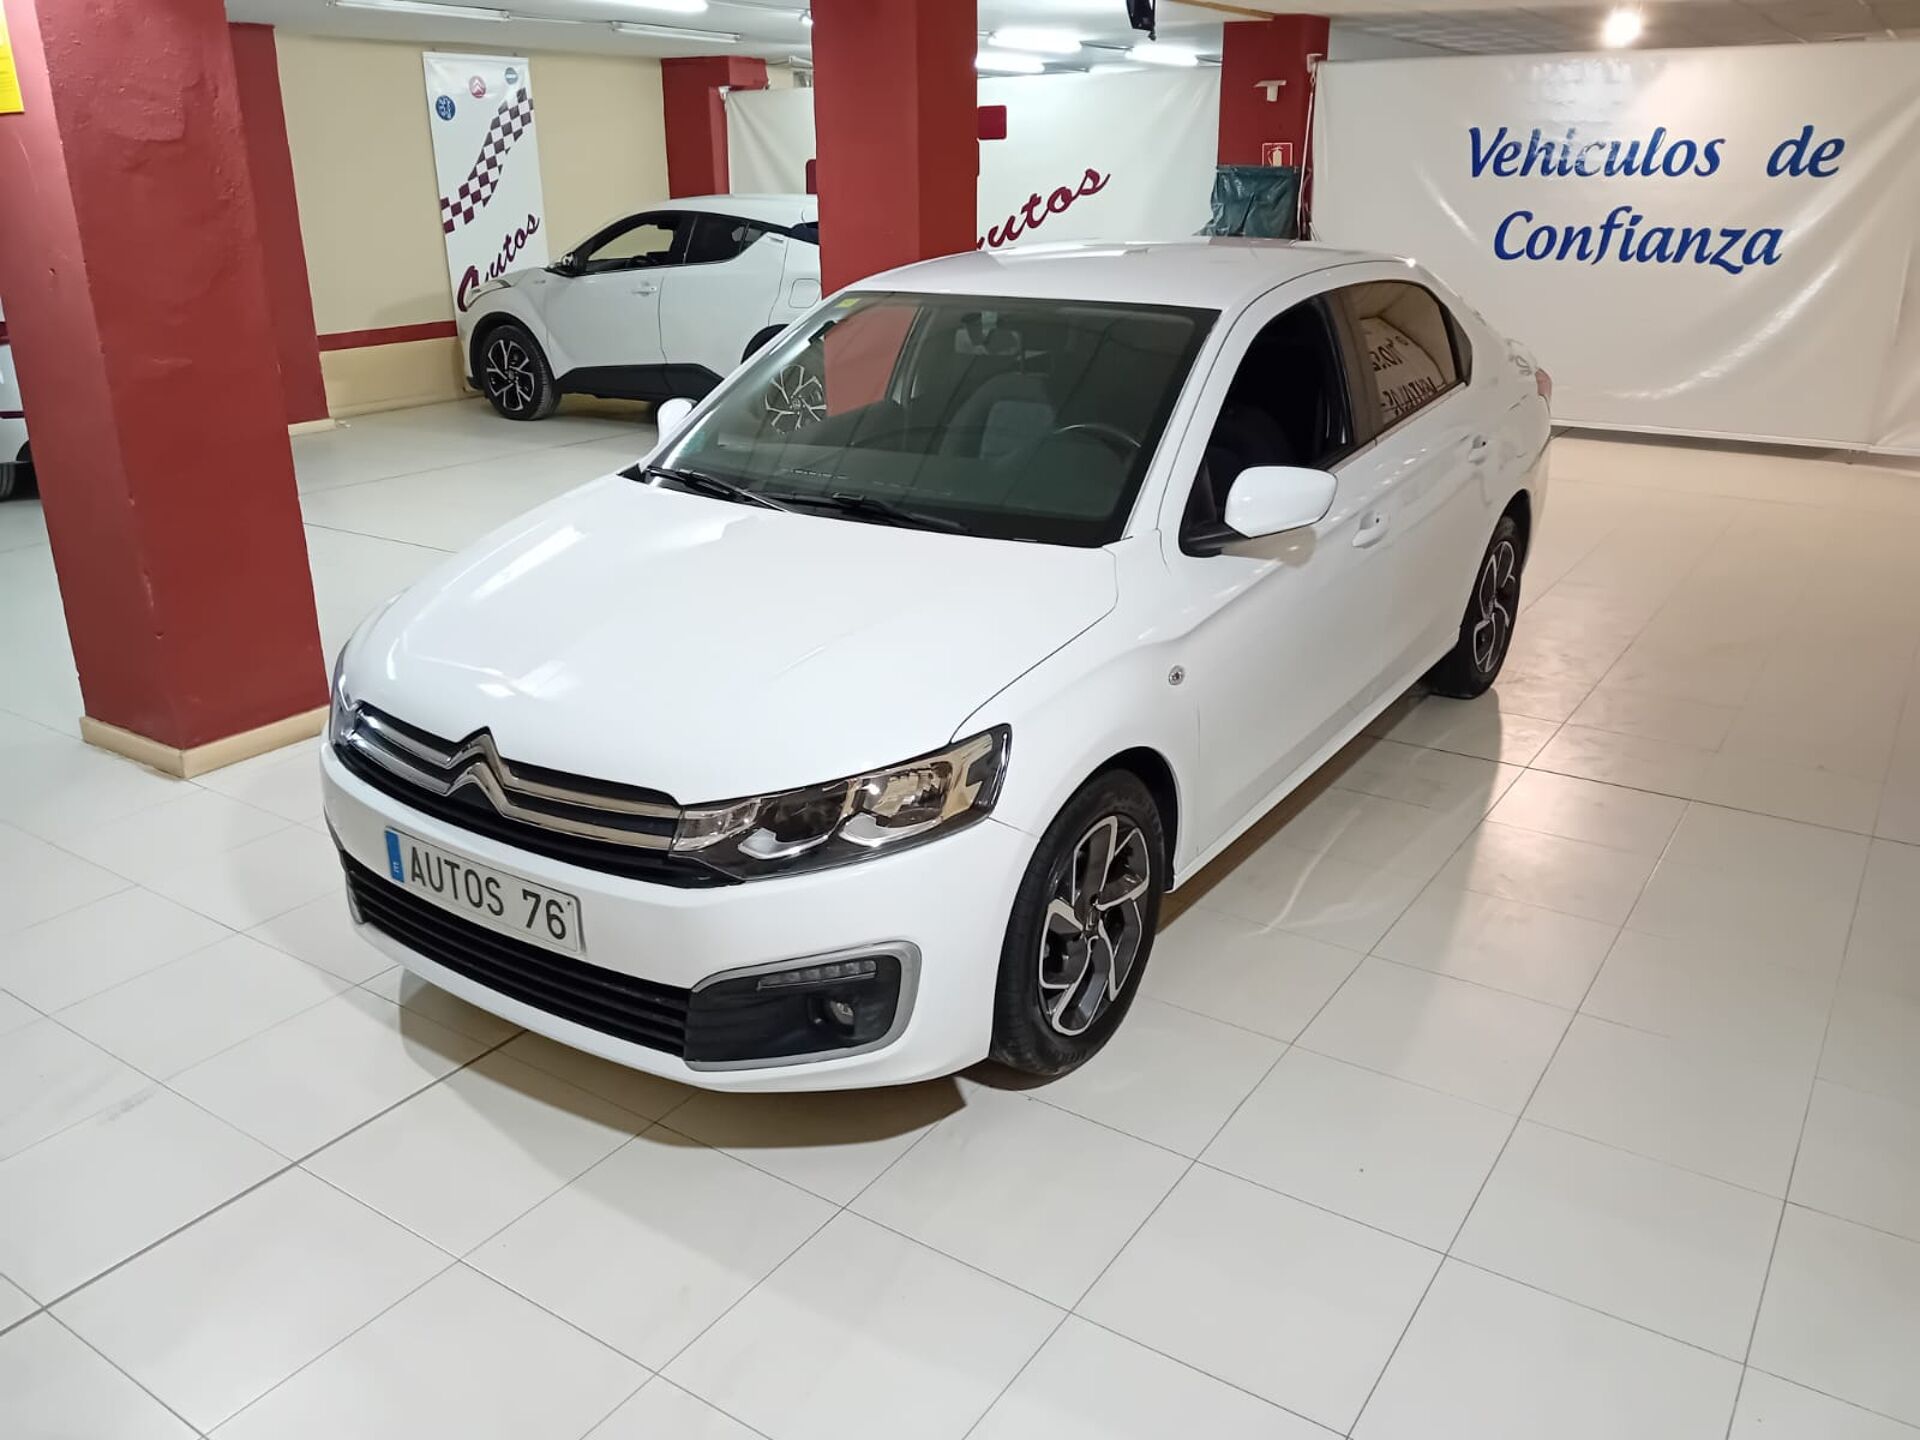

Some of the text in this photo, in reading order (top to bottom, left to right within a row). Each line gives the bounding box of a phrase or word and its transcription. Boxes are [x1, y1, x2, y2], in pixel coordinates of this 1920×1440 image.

[1766, 125, 1845, 178] de
[977, 168, 1111, 249] utos
[1494, 205, 1784, 274] Confianza
[411, 846, 566, 940] AUTOS 76
